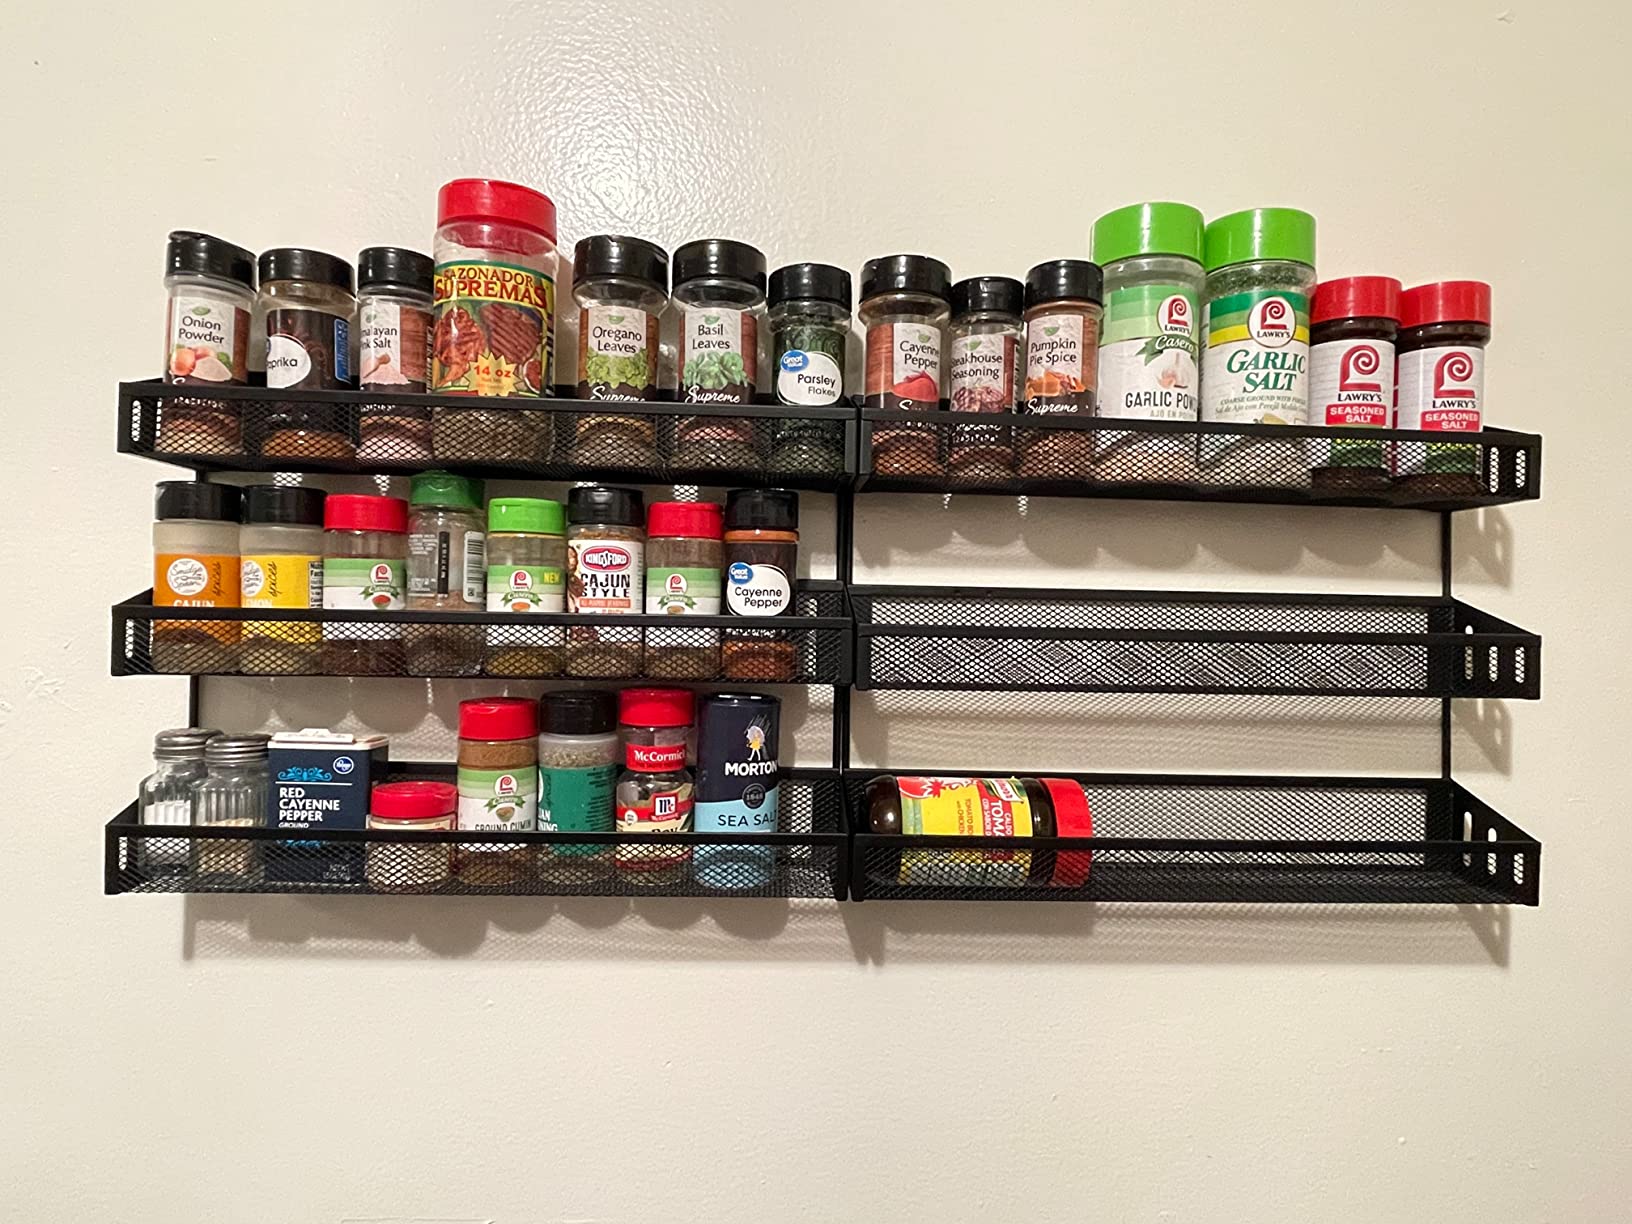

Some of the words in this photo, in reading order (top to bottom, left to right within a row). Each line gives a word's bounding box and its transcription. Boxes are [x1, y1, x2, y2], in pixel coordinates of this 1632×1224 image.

[444, 268, 533, 288] SAZONADOR
[435, 278, 546, 308] SUPREMAS
[183, 315, 221, 331] Onion
[592, 326, 642, 341] Oregano
[698, 324, 723, 336] Basil
[1165, 325, 1190, 335] LAWRY'S
[1257, 330, 1290, 338] LAWRY'S
[179, 328, 224, 345] Powder
[373, 338, 391, 348] Salt
[598, 341, 636, 353] Leaves
[693, 340, 730, 349] Leaves
[1031, 338, 1076, 354] Pumpkin
[1155, 336, 1194, 350] Casero
[266, 357, 298, 370] aprika
[1030, 355, 1042, 366] Pie
[1046, 352, 1076, 365] Spice
[1227, 349, 1305, 374] GARLIC
[474, 365, 490, 375] 14
[495, 369, 511, 377] oz
[798, 374, 836, 388] Parsley
[1243, 372, 1296, 393] SALT
[685, 386, 740, 403] Supreme
[808, 387, 835, 397] Flakes
[1338, 393, 1382, 402] LAWRY'S
[1125, 391, 1172, 408] GARLIC
[1432, 400, 1476, 408] LAWRY'S
[1025, 398, 1078, 415] Supreme
[1330, 407, 1384, 415] SEASONED
[1425, 413, 1478, 421] SEASONED
[1441, 421, 1467, 429] SALT
[585, 551, 627, 567] KINGSFORD
[581, 574, 630, 588] CAJUN
[582, 588, 629, 597] STYLE
[735, 587, 782, 597] Cayenne
[744, 597, 782, 608] Pepper
[725, 761, 777, 776] MORTON
[279, 787, 305, 798] RED
[279, 799, 340, 811] CAYENNE
[279, 810, 323, 821] PEPPER
[718, 815, 748, 826] SEA
[1004, 812, 1012, 836] CALDO
